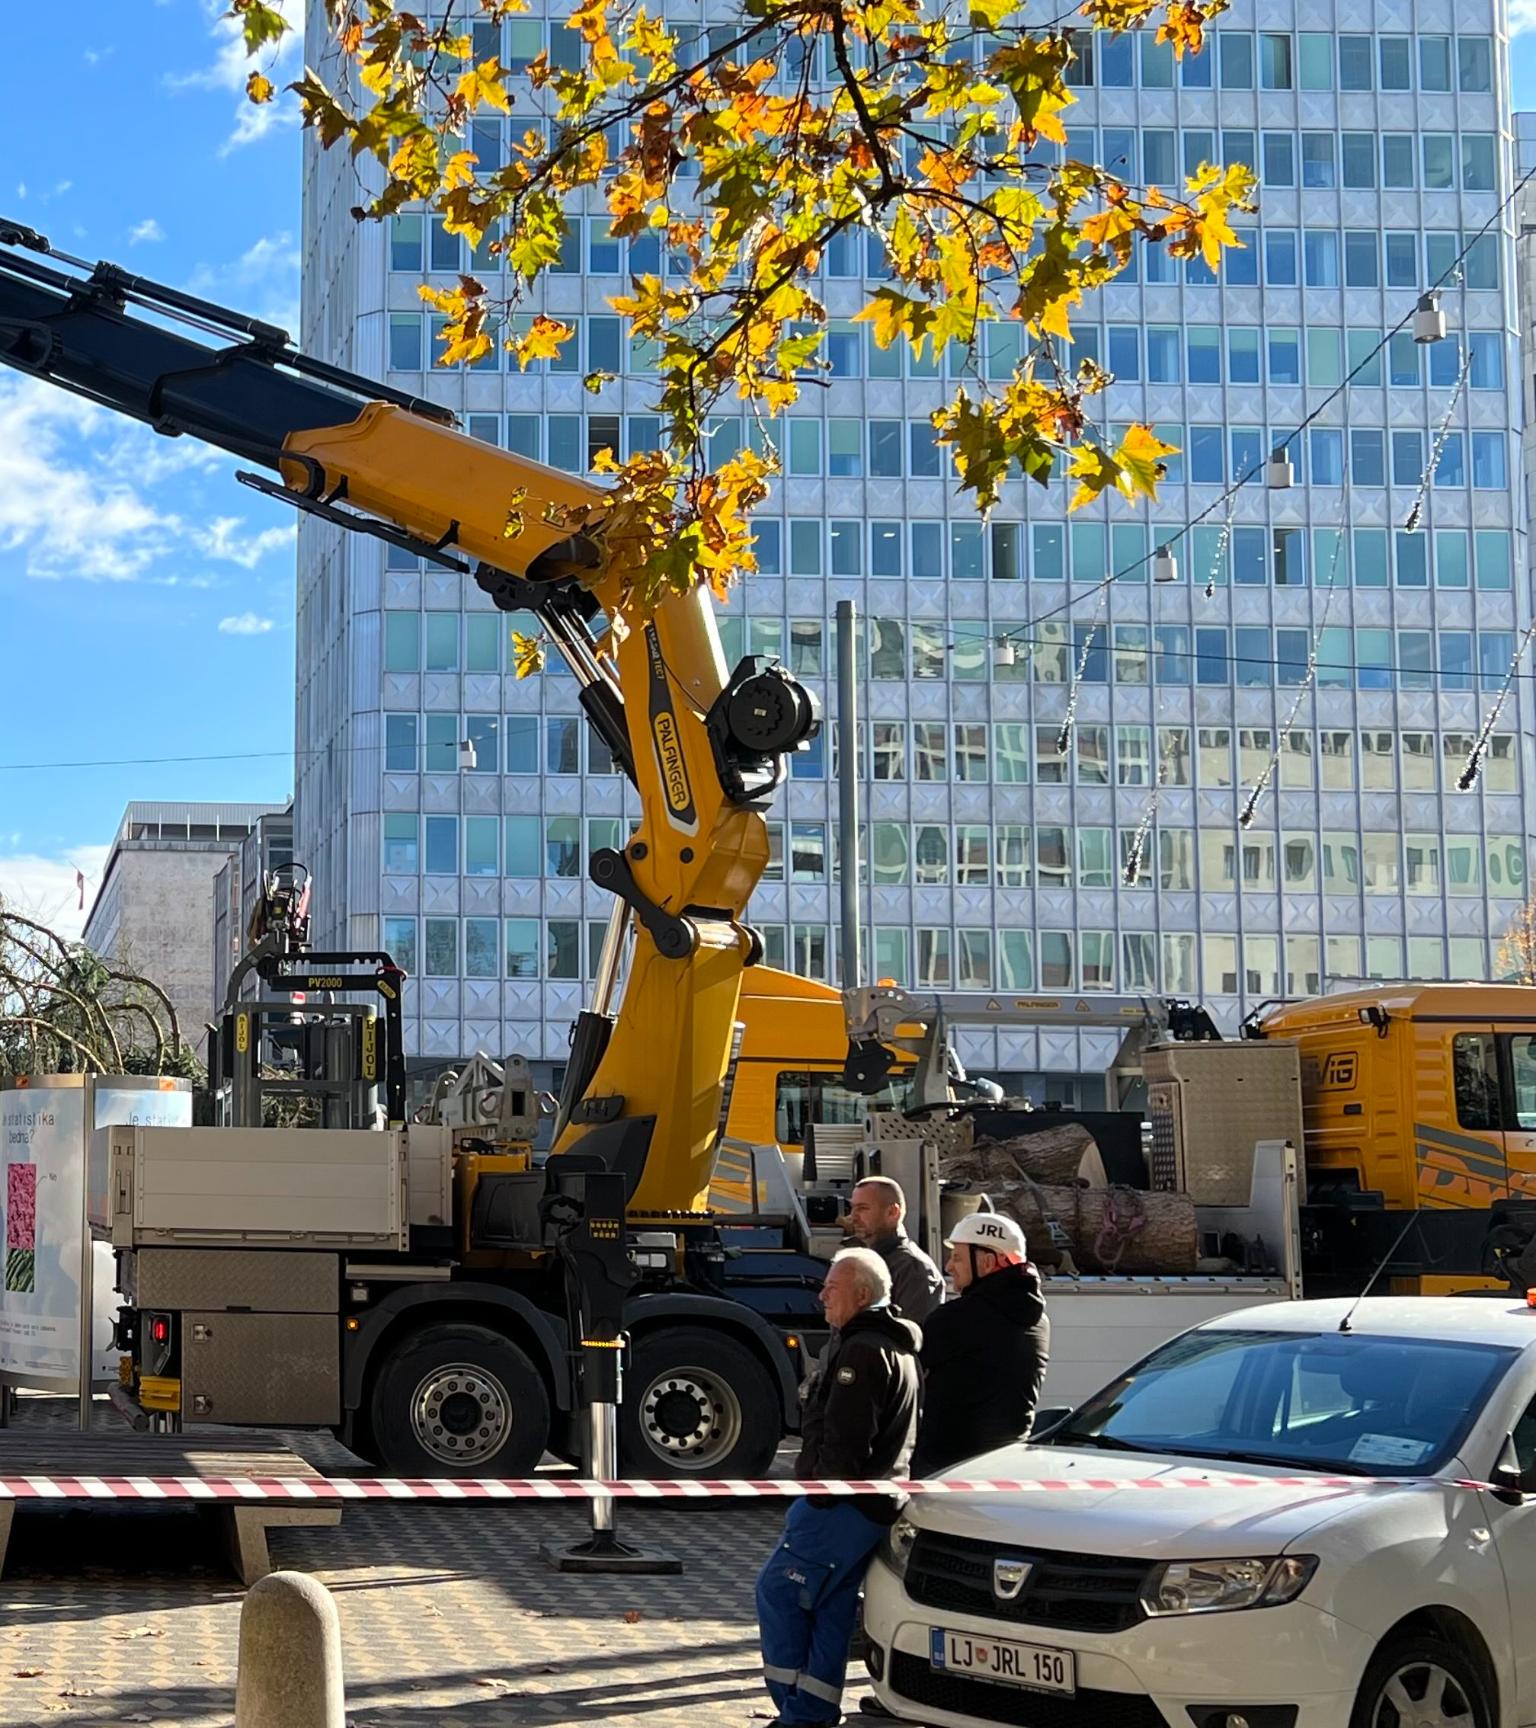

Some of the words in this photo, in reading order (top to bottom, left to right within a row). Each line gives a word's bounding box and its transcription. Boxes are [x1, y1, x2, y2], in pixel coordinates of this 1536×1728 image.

[657, 717, 687, 806] PALFINGER
[308, 977, 343, 988] PV2000
[366, 1019, 375, 1076] BIJOL
[976, 1223, 1007, 1240] JRL
[951, 1638, 973, 1667] LJ
[991, 1645, 1026, 1678] JRL
[1033, 1652, 1064, 1684] 150
